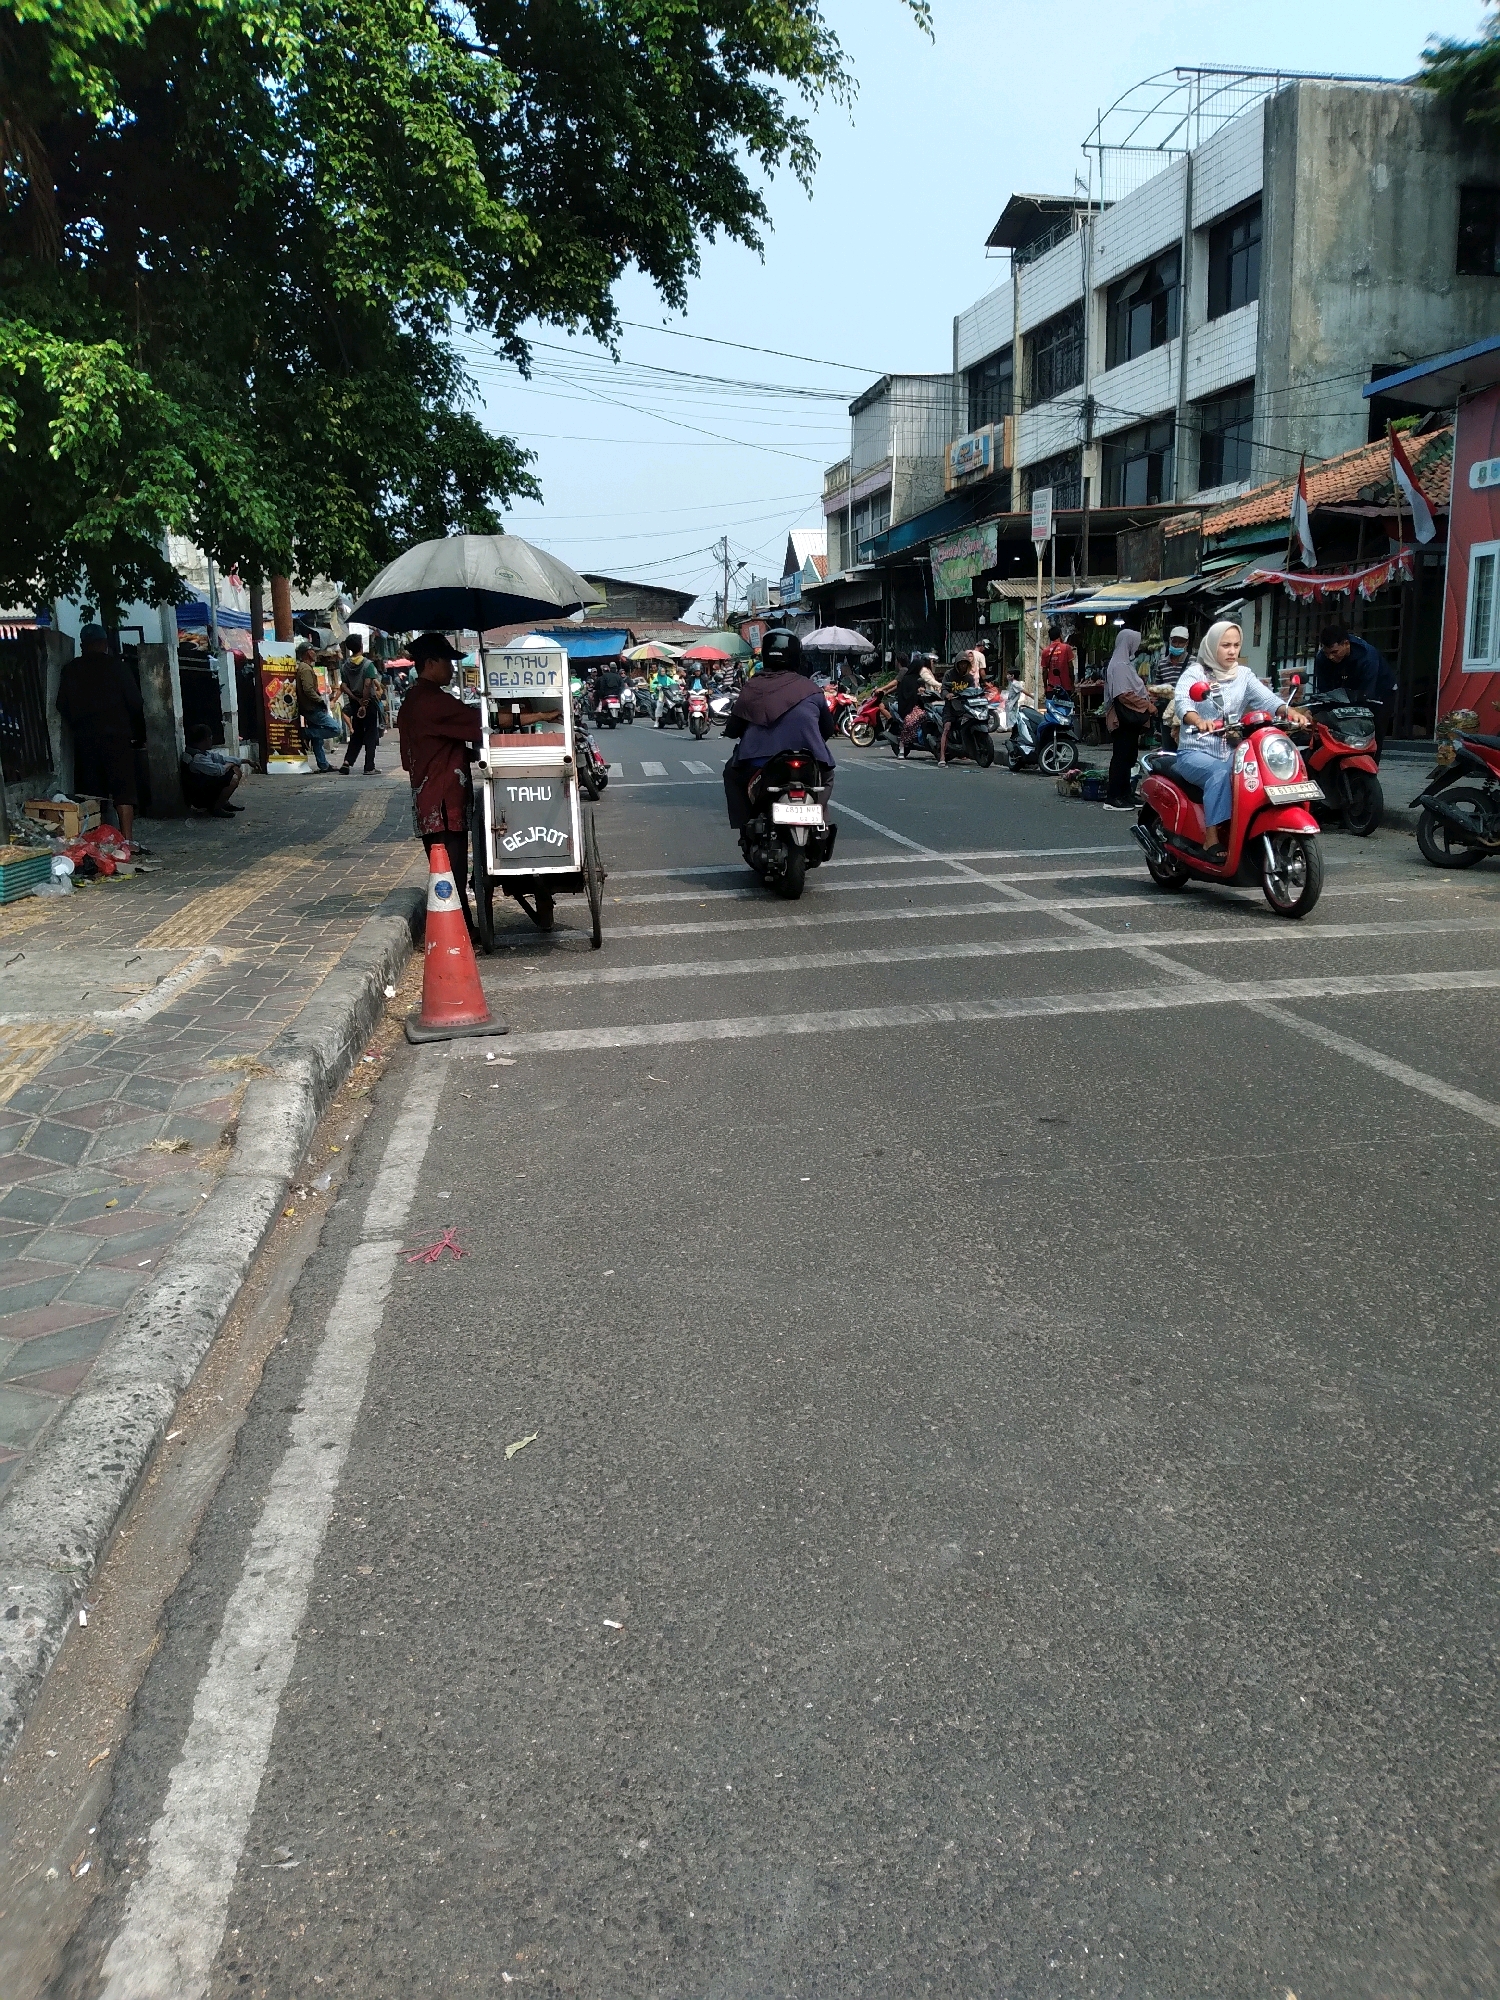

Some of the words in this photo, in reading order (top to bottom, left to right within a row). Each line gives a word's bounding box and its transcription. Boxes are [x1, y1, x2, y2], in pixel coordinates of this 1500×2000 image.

[503, 655, 548, 669] TAHU
[488, 671, 557, 686] GEJROT
[506, 785, 552, 801] TAHU
[1269, 788, 1276, 796] B
[502, 826, 569, 852] GEJROT
